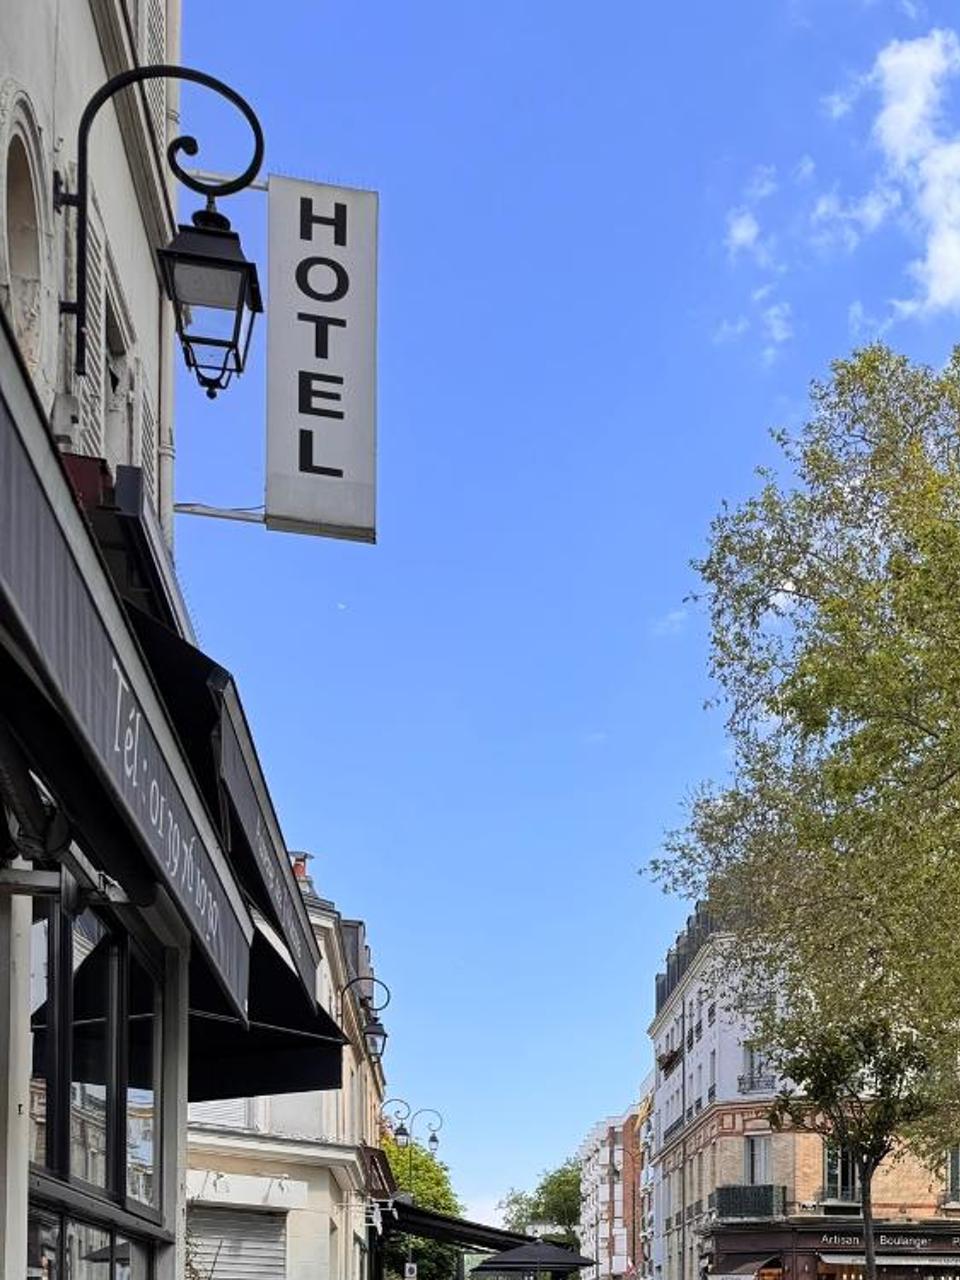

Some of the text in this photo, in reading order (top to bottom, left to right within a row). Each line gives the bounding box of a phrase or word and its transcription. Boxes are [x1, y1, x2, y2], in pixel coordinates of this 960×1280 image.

[295, 196, 349, 478] HOTEL
[149, 779, 167, 838] 01
[821, 1233, 860, 1246] Artisan
[879, 1234, 932, 1249] Boulanger
